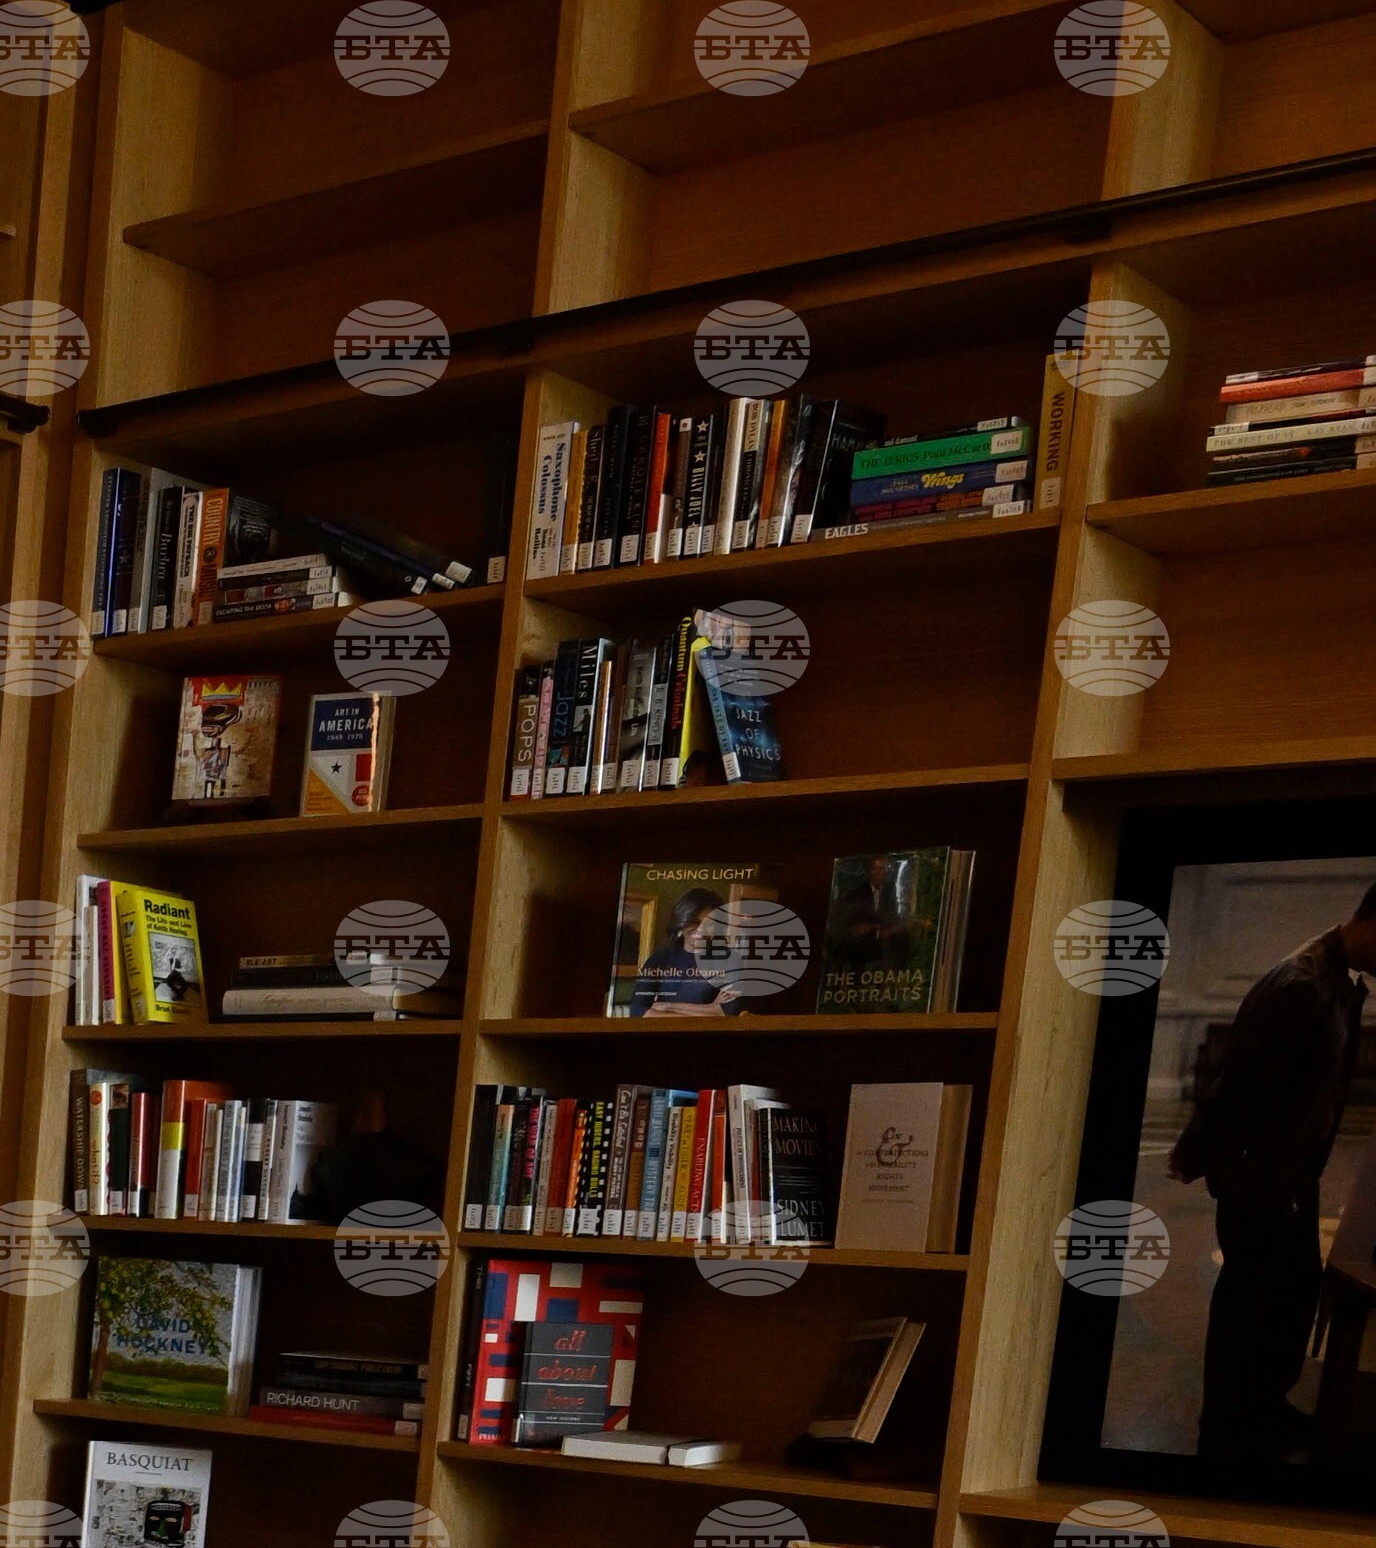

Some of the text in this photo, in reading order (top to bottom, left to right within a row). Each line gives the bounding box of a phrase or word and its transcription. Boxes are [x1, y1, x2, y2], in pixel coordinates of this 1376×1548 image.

[1047, 392, 1065, 471] WORKING
[538, 455, 552, 515] Colossus
[549, 443, 566, 522] Saxophone
[920, 472, 964, 488] Wings
[688, 467, 705, 518] BILLY JOEL
[203, 498, 223, 545] COUNTRY
[825, 523, 868, 539] EAGLES
[677, 616, 692, 672] Quantum
[579, 645, 597, 699] Miles
[334, 708, 349, 717] ART
[736, 708, 763, 723] JAZZ
[319, 718, 373, 732] AMERICA
[518, 703, 536, 763] POPS
[745, 728, 760, 740] OF
[735, 742, 781, 761] PHYSICS
[646, 868, 754, 881] CHASING LIGHT
[144, 899, 191, 920] Radiant
[636, 967, 726, 978] Michelle Obama
[826, 968, 924, 986] THE OBAMA
[824, 987, 922, 1004] PORTRAITS
[74, 1097, 84, 1156] WATERSHIP
[777, 1199, 825, 1216] SIDNEY
[781, 1221, 824, 1237] LUMET
[135, 1317, 190, 1334] DAVID
[116, 1334, 206, 1354] HOCKNEY
[555, 1330, 587, 1352] all
[536, 1358, 597, 1382] about
[266, 1391, 360, 1412] RICHARD HUNT
[544, 1389, 584, 1410] love
[106, 1451, 193, 1471] BASQUIAT
